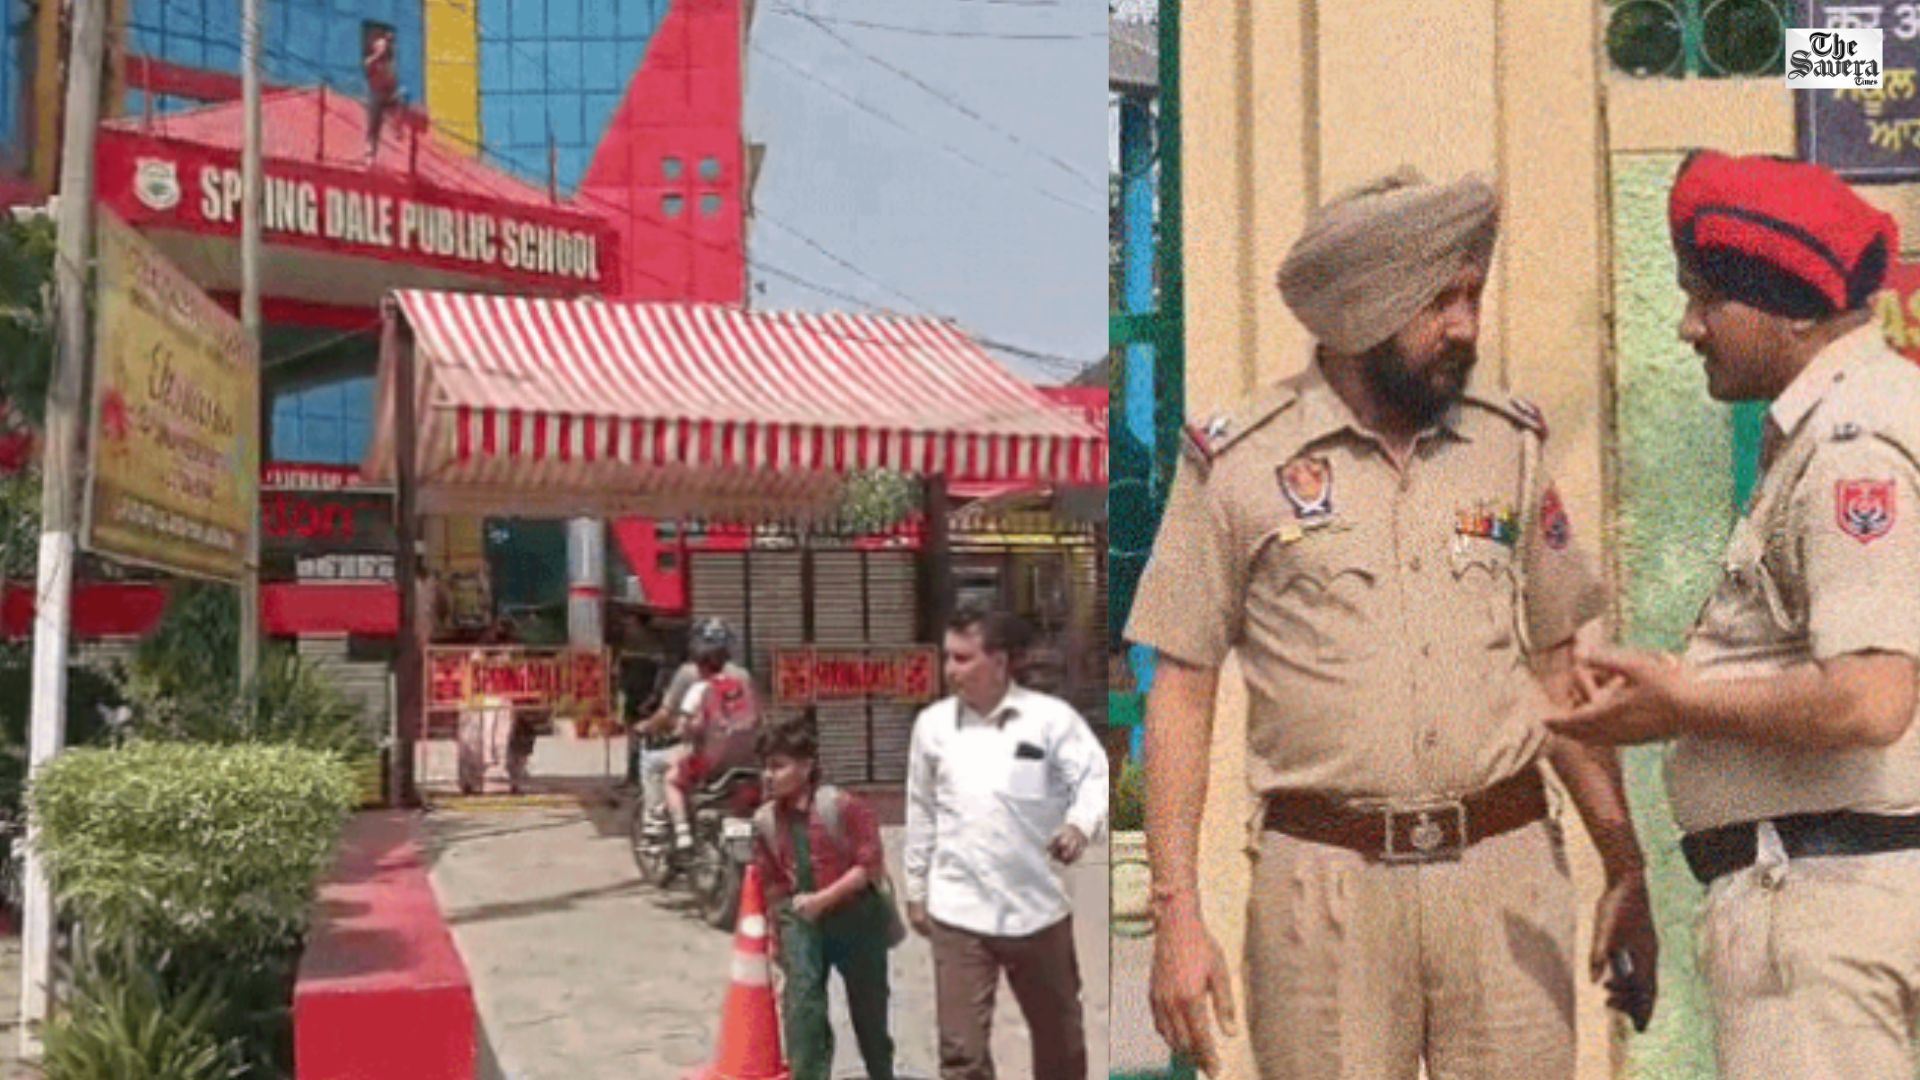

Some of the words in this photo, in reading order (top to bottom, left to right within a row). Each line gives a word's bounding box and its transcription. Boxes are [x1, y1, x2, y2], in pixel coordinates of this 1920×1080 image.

[200, 164, 319, 236] SPING
[324, 185, 393, 247] DALE
[400, 199, 496, 264] PUBLIC
[502, 218, 600, 281] SCHOOL
